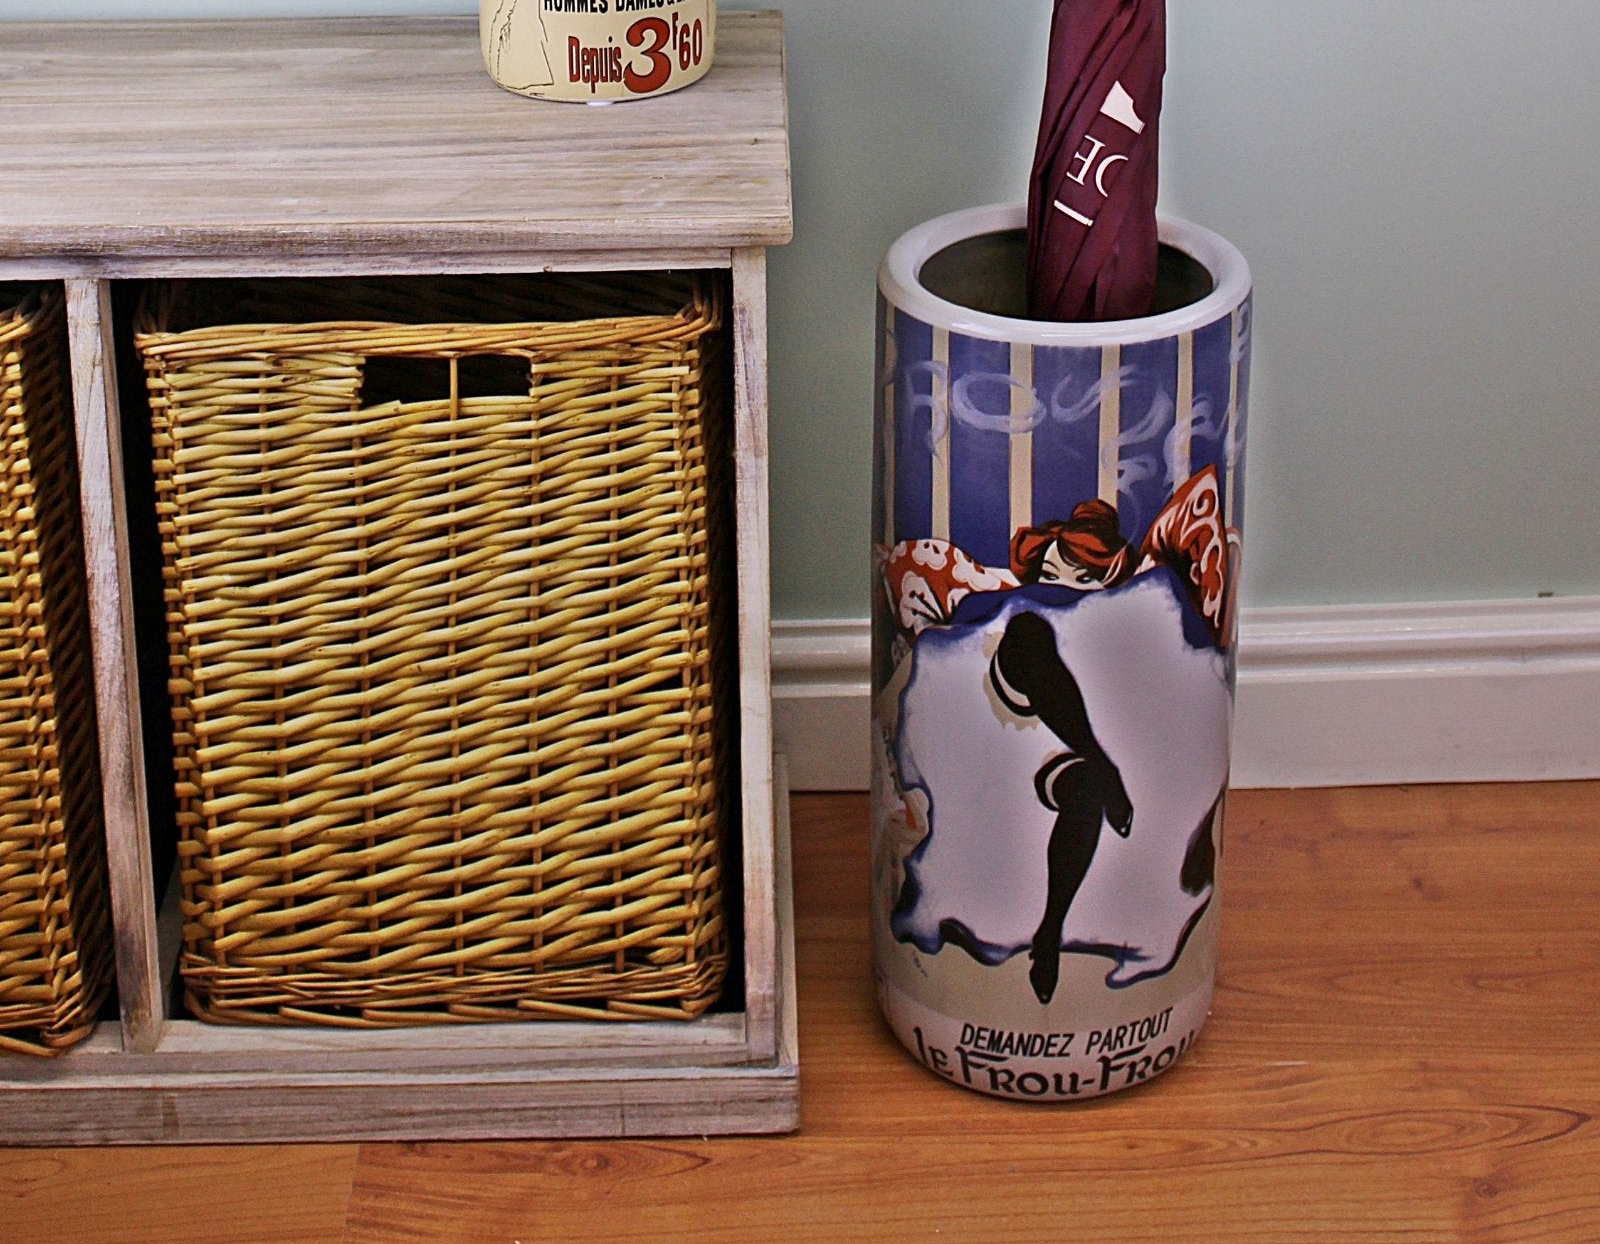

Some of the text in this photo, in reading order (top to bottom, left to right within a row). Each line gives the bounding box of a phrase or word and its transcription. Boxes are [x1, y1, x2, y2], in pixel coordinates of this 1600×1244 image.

[567, 36, 623, 94] Depuis
[960, 1006, 1174, 1057] DEMANDEZ PARTOUT
